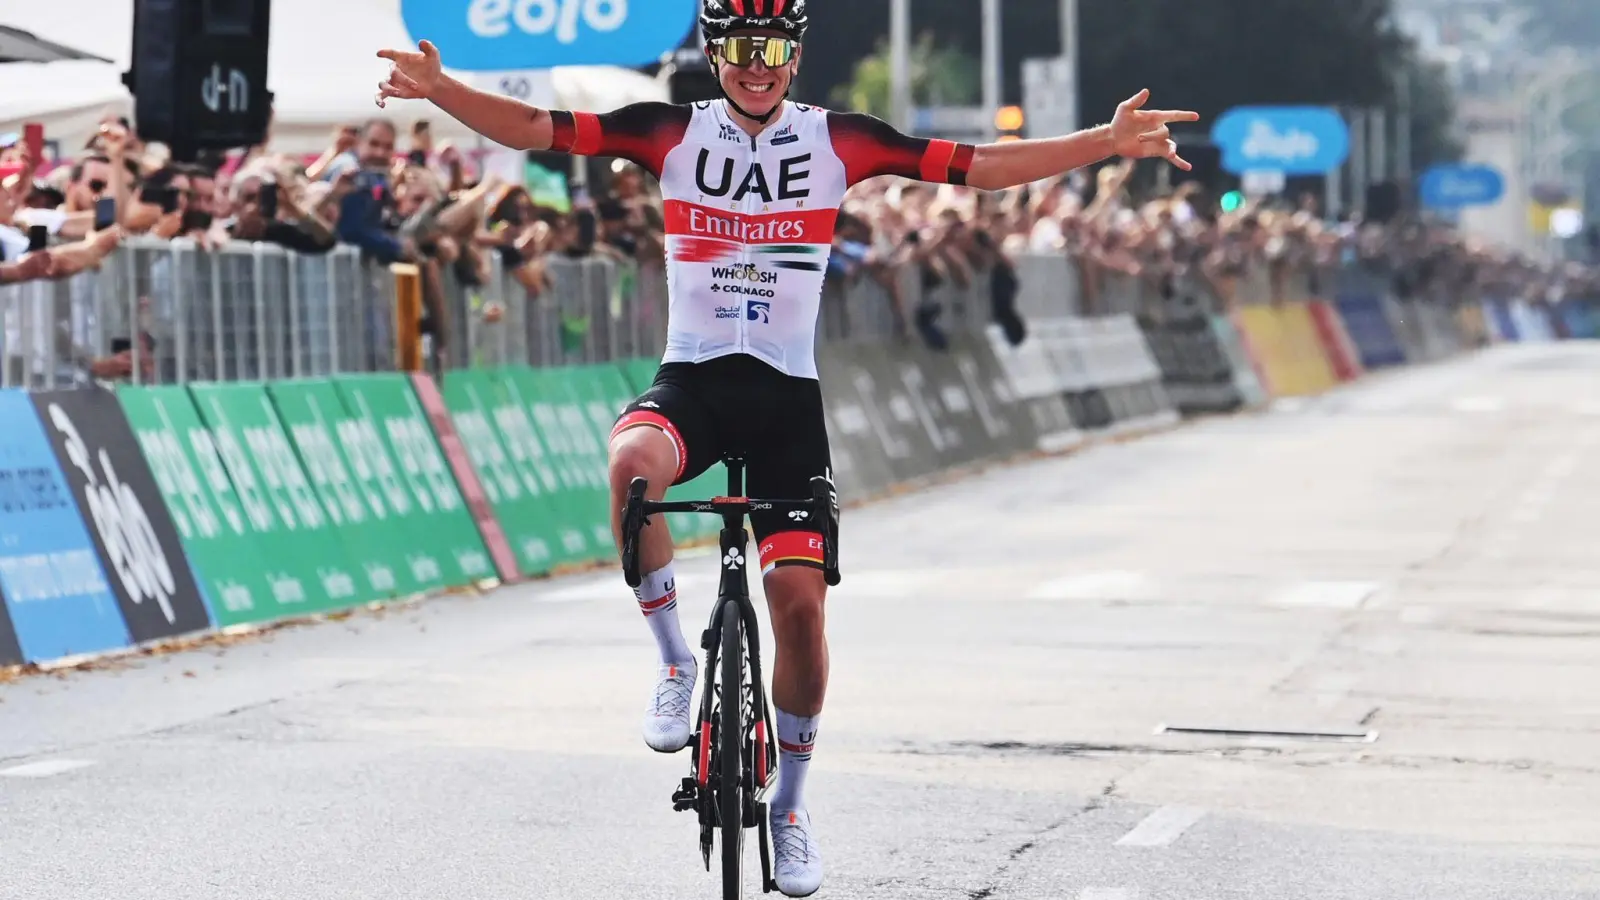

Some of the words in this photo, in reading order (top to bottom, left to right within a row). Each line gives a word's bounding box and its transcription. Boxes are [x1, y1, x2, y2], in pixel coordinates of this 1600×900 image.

[695, 146, 812, 203] UAE
[689, 208, 805, 241] Emirates
[711, 266, 778, 284] WHOOSH
[722, 284, 775, 298] COLNAGO
